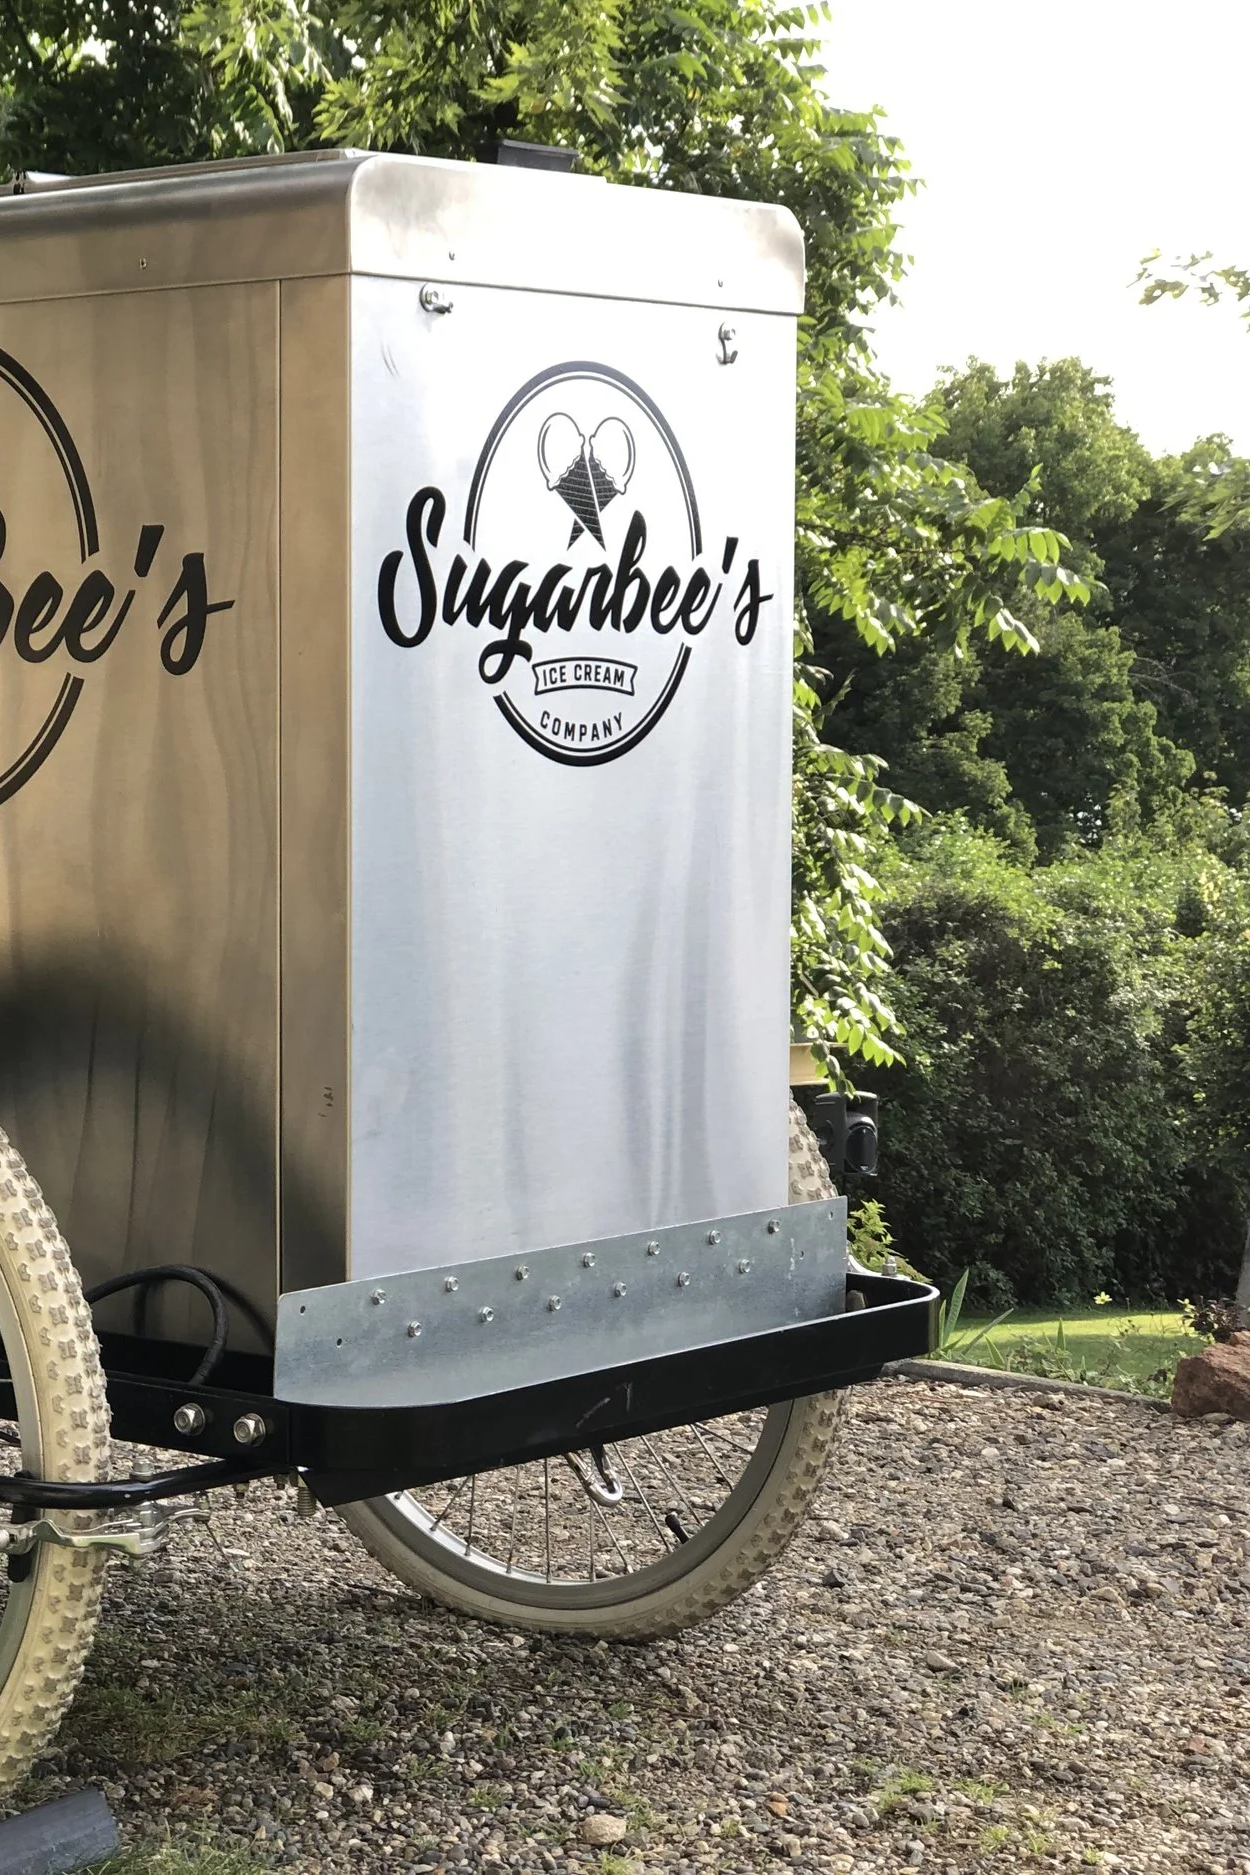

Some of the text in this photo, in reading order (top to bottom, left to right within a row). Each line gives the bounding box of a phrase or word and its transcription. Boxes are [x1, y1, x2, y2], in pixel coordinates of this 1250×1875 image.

[377, 486, 774, 685] Sugarbee's
[542, 663, 626, 688] ICE CREAM
[539, 710, 625, 743] COMPANY
